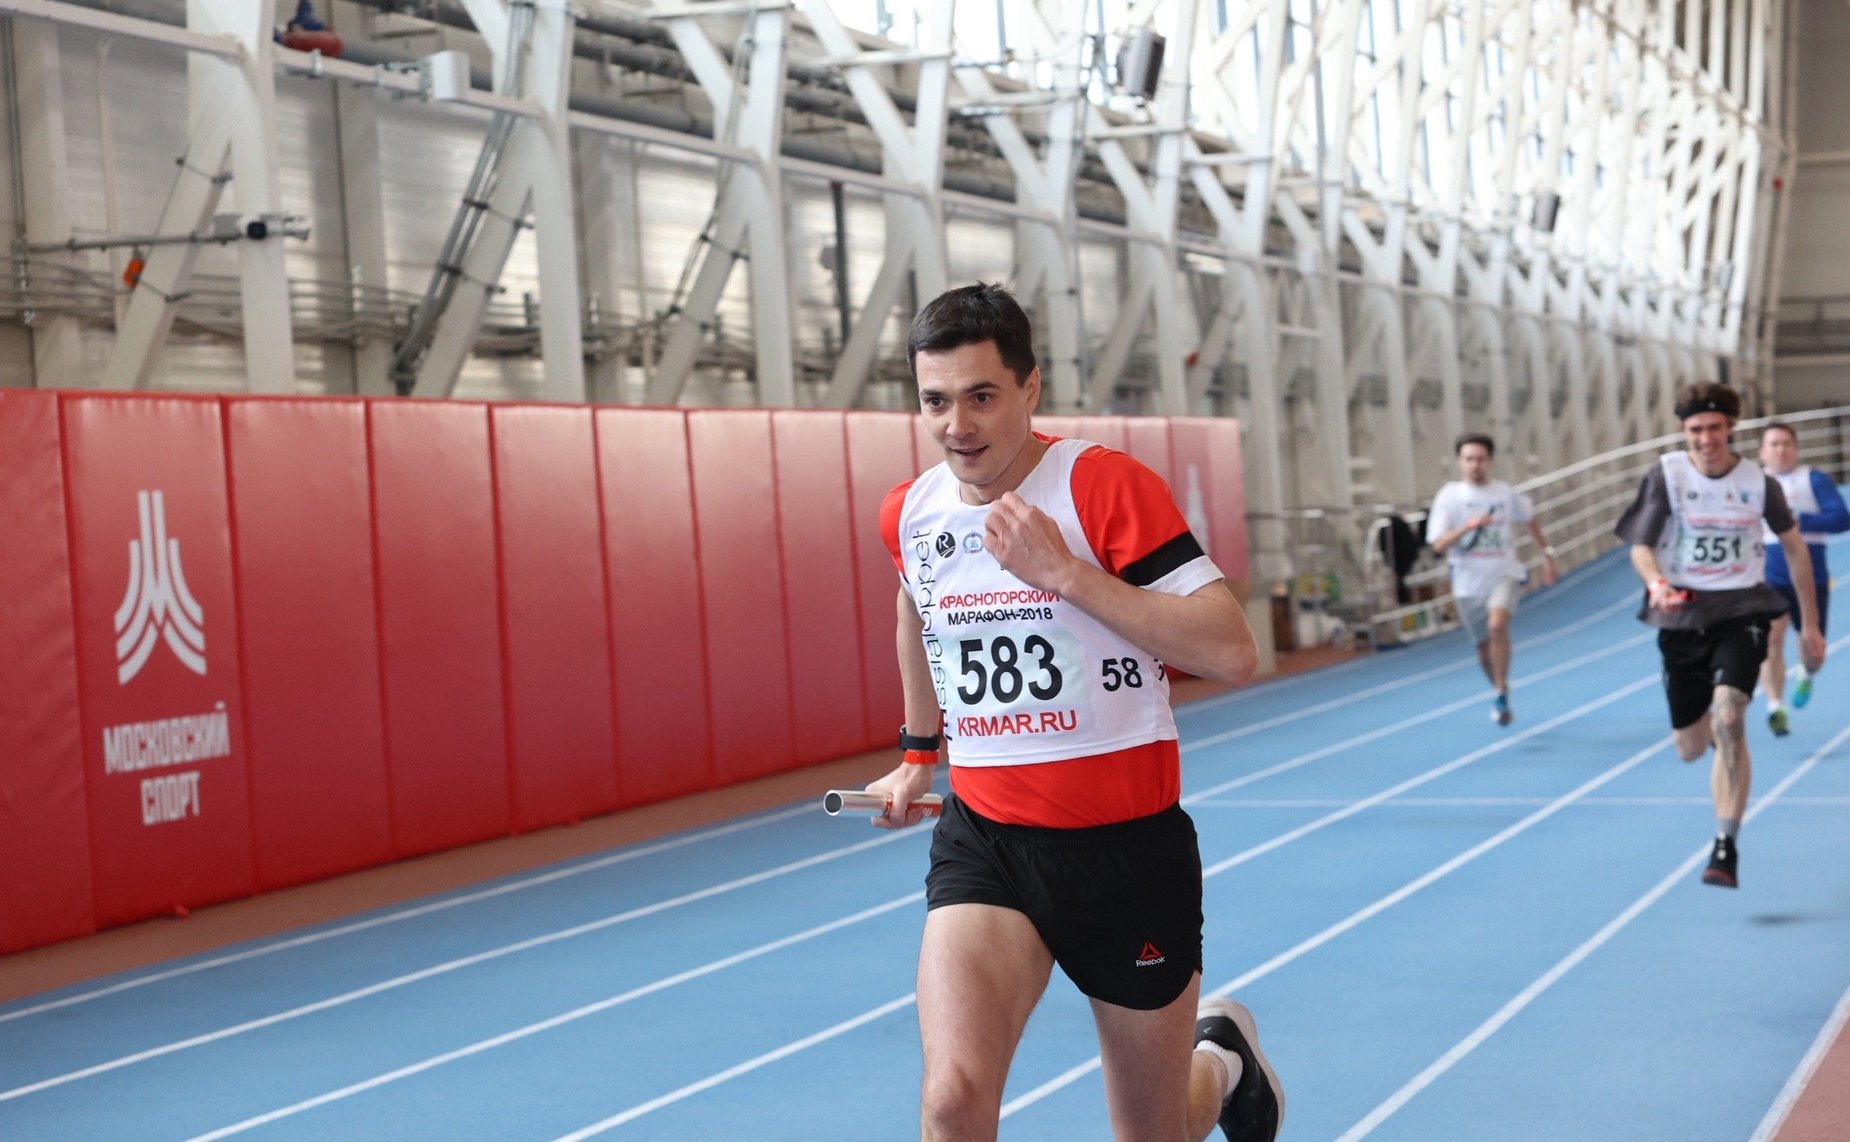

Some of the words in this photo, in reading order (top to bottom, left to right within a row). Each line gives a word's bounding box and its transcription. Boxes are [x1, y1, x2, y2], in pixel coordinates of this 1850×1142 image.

[1694, 535, 1741, 563] 551
[947, 607, 1054, 626] МАРАФОН-2018
[957, 634, 1063, 705] 583
[957, 709, 1078, 737] KRMAR.RU
[103, 701, 231, 775] МОСКОВСКИЙ
[141, 770, 201, 826] СПОРТ
[1135, 956, 1166, 967] Reebok
